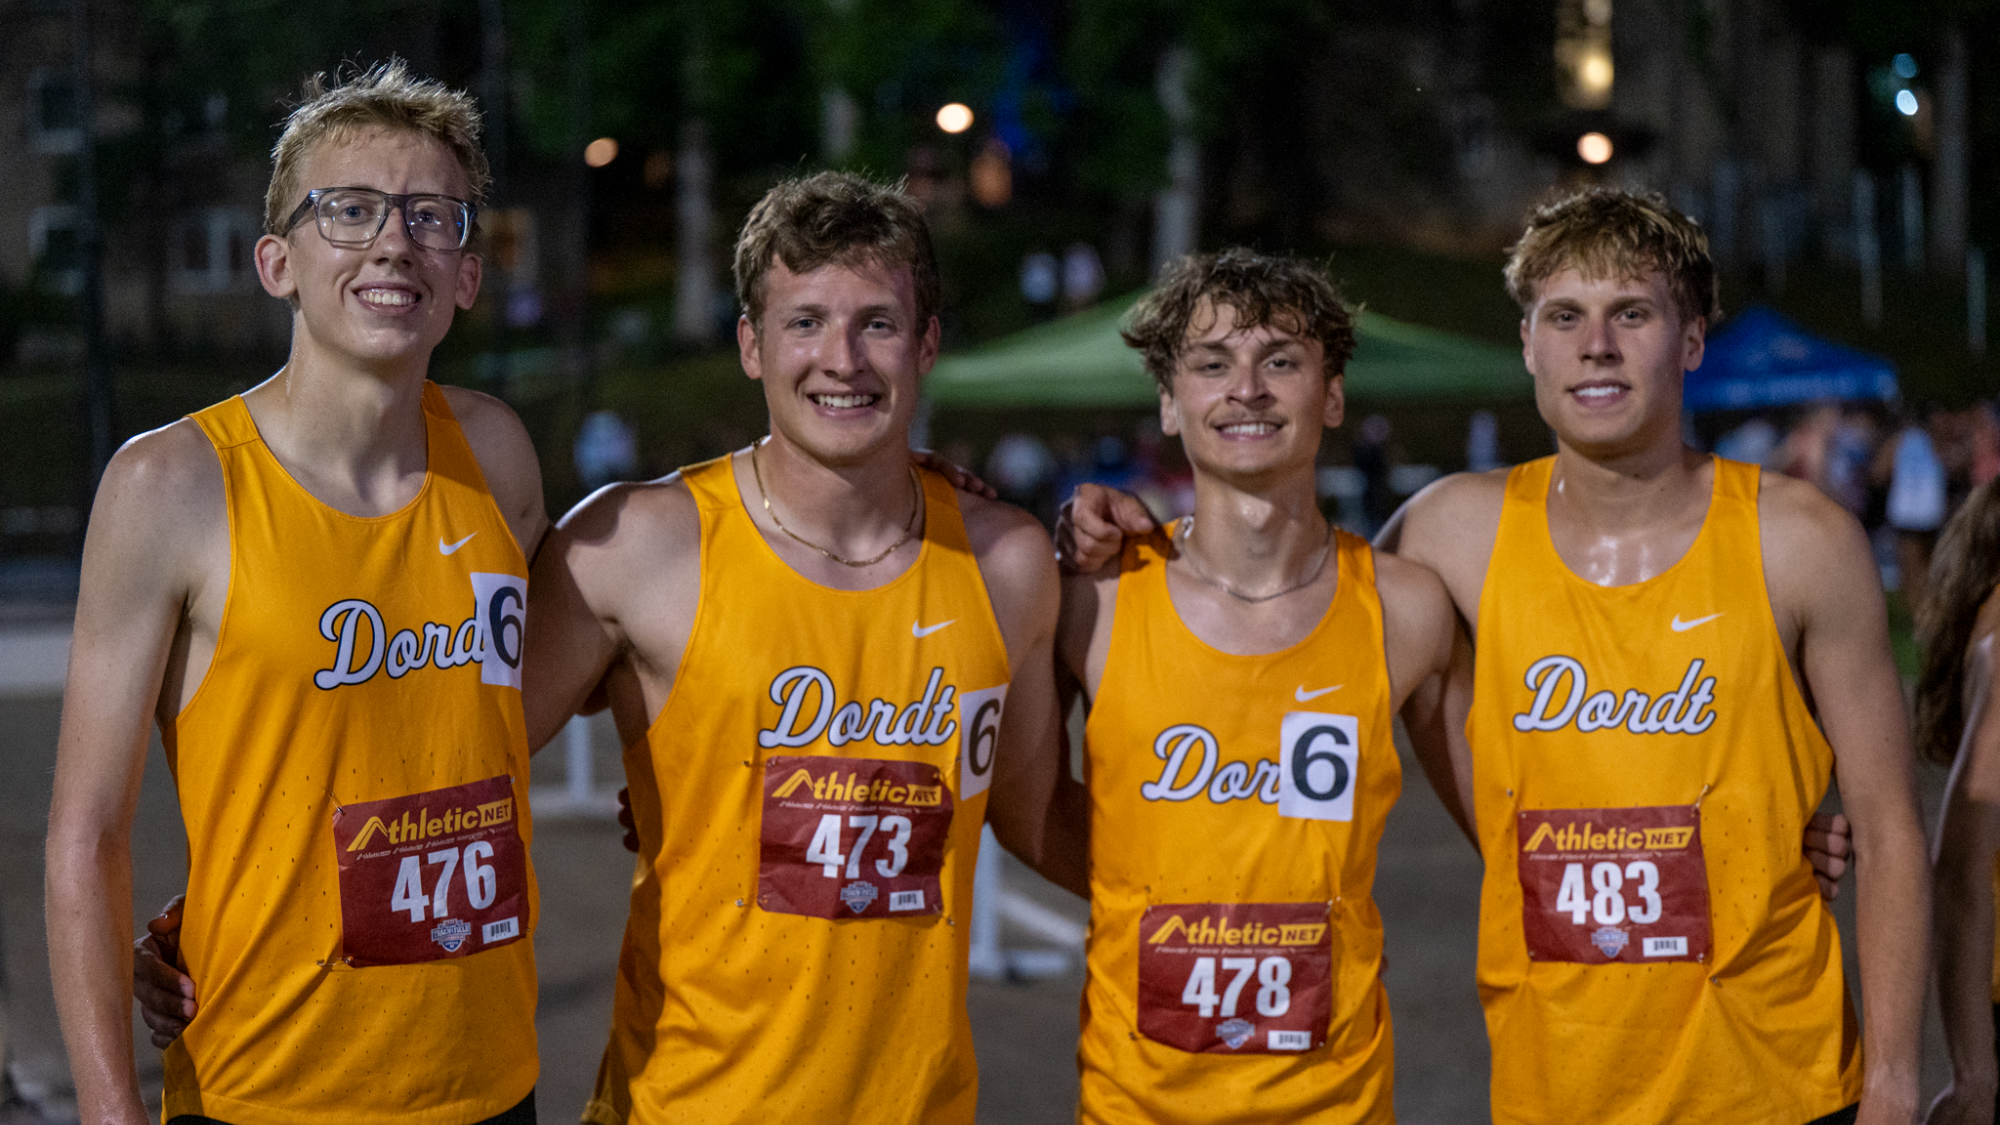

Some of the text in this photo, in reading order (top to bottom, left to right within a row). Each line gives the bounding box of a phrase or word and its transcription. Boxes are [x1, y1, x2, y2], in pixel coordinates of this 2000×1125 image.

[313, 598, 484, 690] Dord
[488, 586, 524, 670] 6
[758, 665, 956, 749] Dordt
[1513, 654, 1717, 735] Dordt
[969, 698, 1000, 776] 6
[1140, 723, 1280, 804] Dor
[1292, 724, 1350, 802] 6
[391, 840, 497, 923] 476
[806, 814, 912, 879] 473
[1556, 861, 1662, 925] 483
[1181, 956, 1292, 1018] 478
